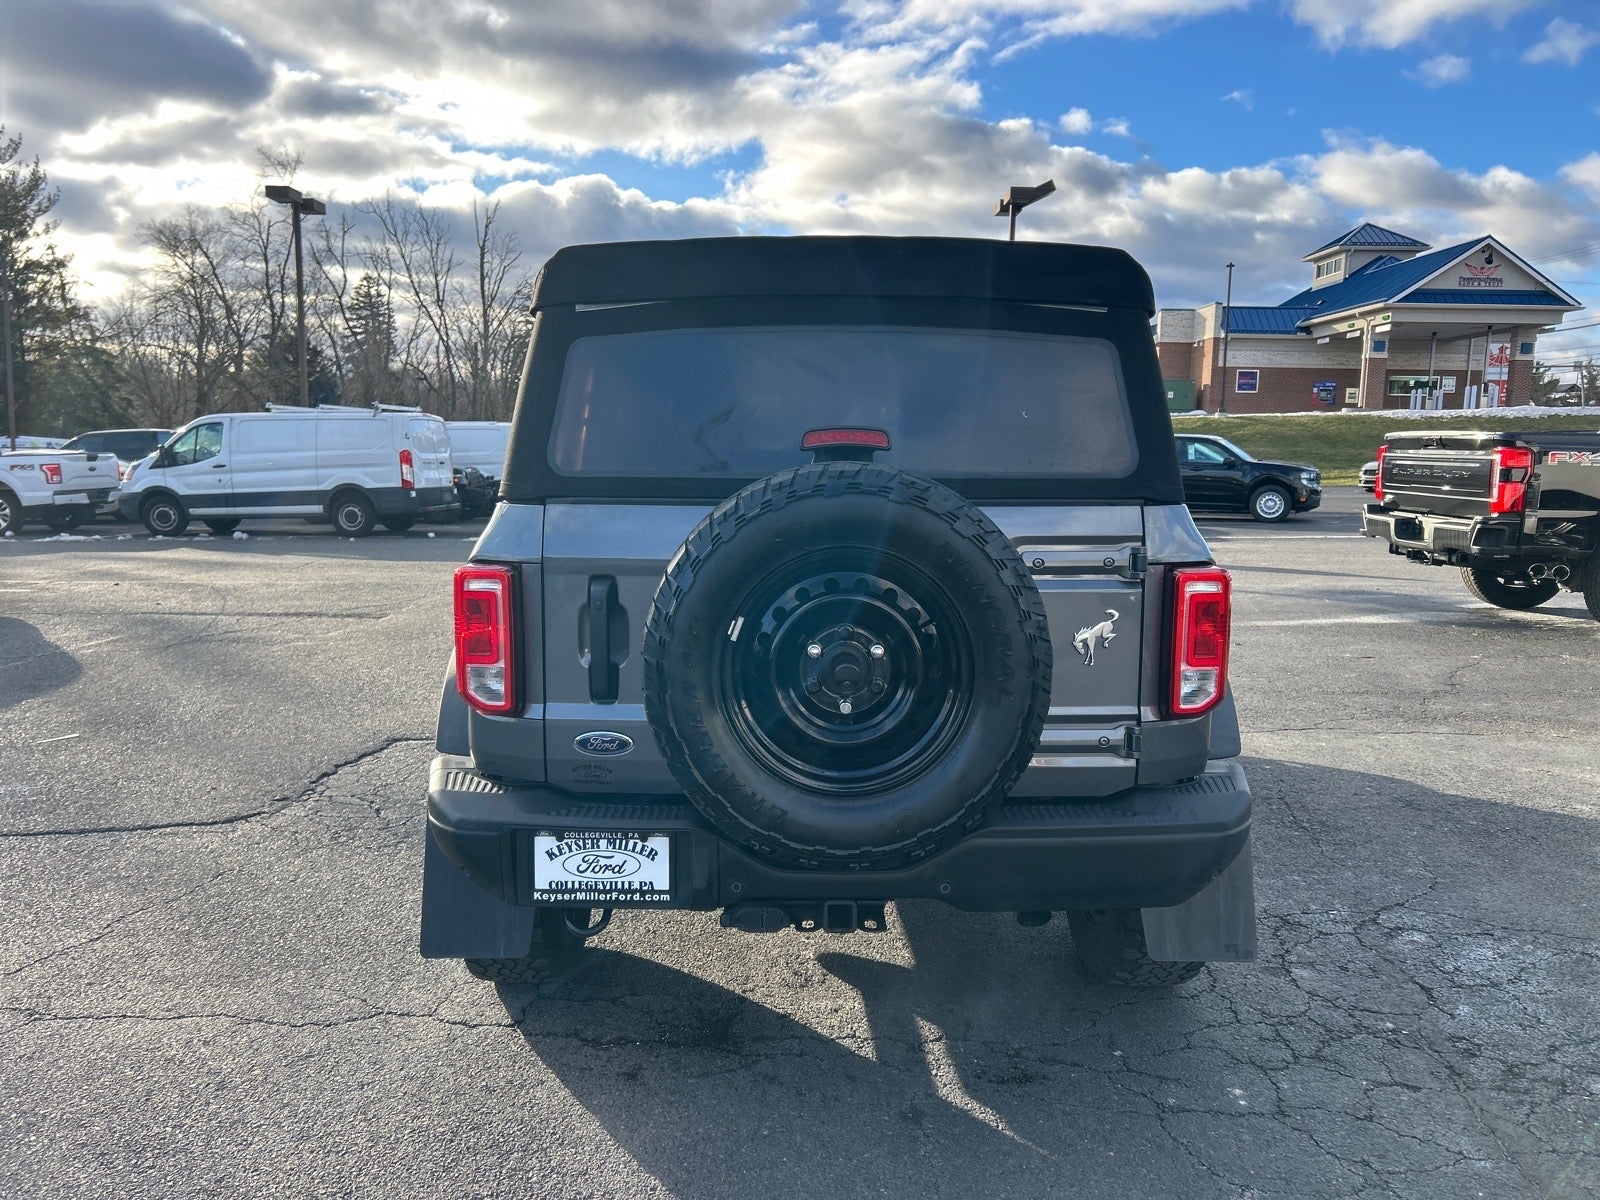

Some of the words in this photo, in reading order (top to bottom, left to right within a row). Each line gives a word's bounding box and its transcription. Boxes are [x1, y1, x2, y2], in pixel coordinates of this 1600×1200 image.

[587, 736, 619, 751] Ford
[564, 831, 625, 839] COLLEGEVILLE,
[544, 839, 601, 861] KEYSER
[606, 839, 659, 862] MILLER
[576, 853, 627, 875] Ford
[533, 891, 670, 901] KeyserMillerFord.com
